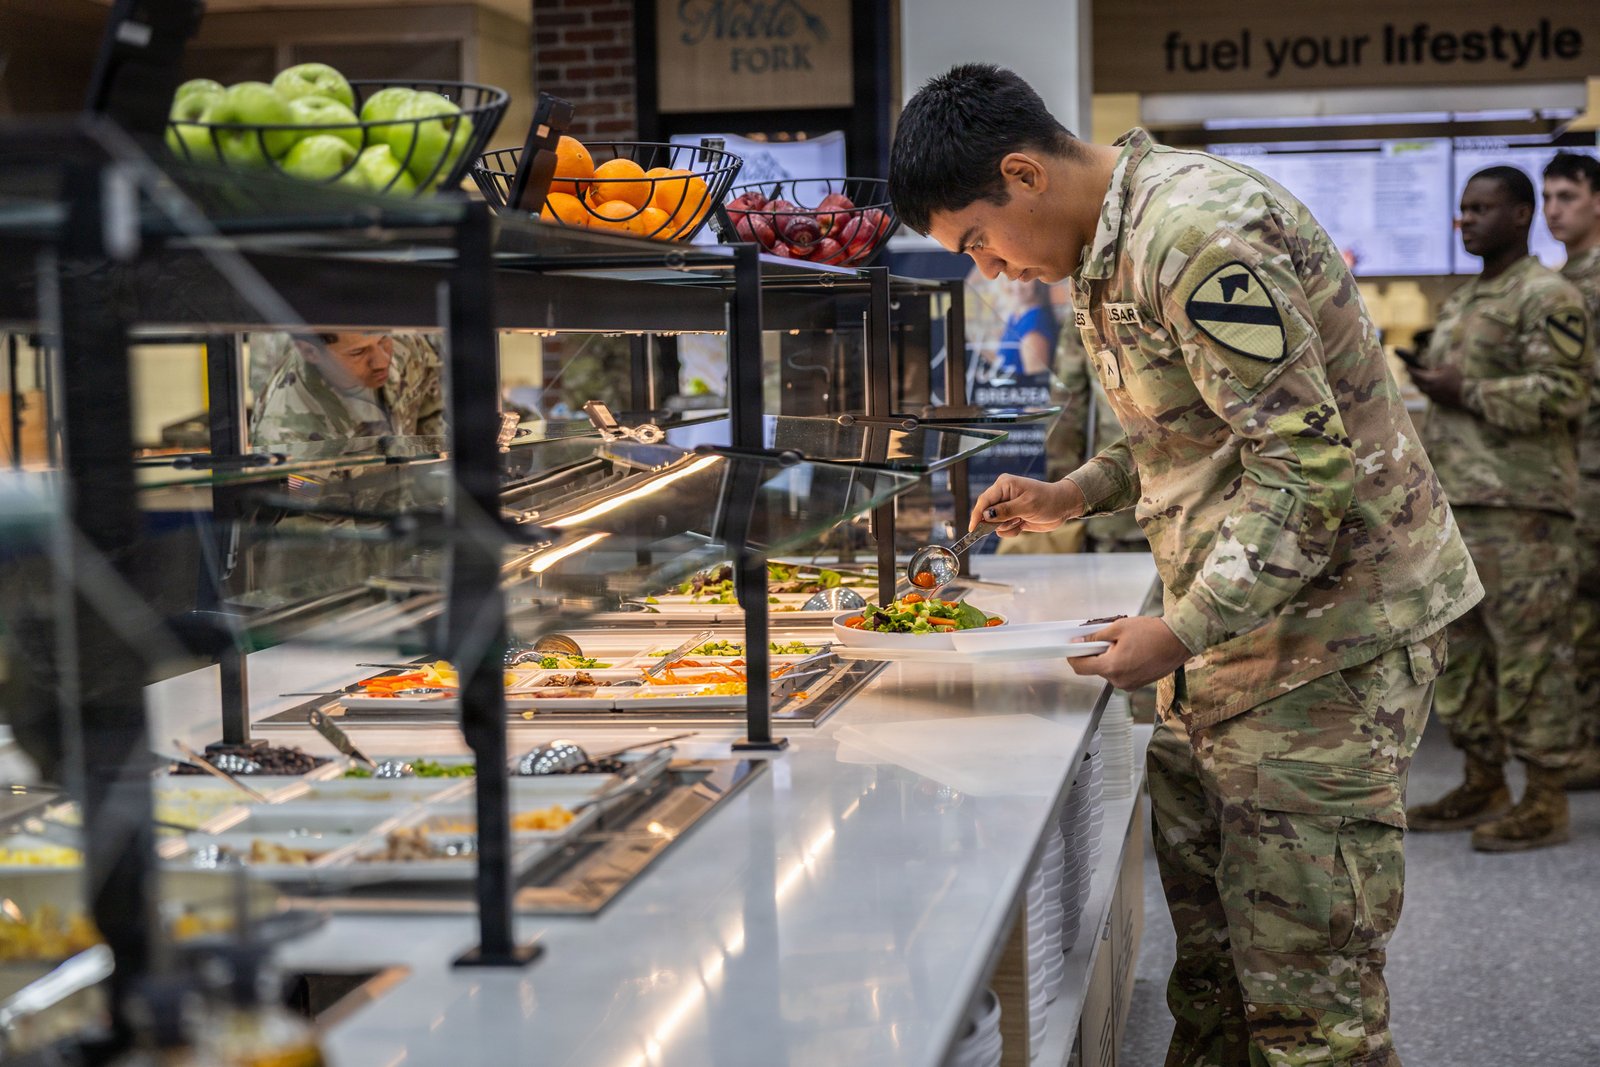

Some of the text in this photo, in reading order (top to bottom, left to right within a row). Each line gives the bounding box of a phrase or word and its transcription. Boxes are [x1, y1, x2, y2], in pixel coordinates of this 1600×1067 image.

[730, 44, 815, 73] FORK
[1164, 17, 1583, 79] fuel your lifestyle
